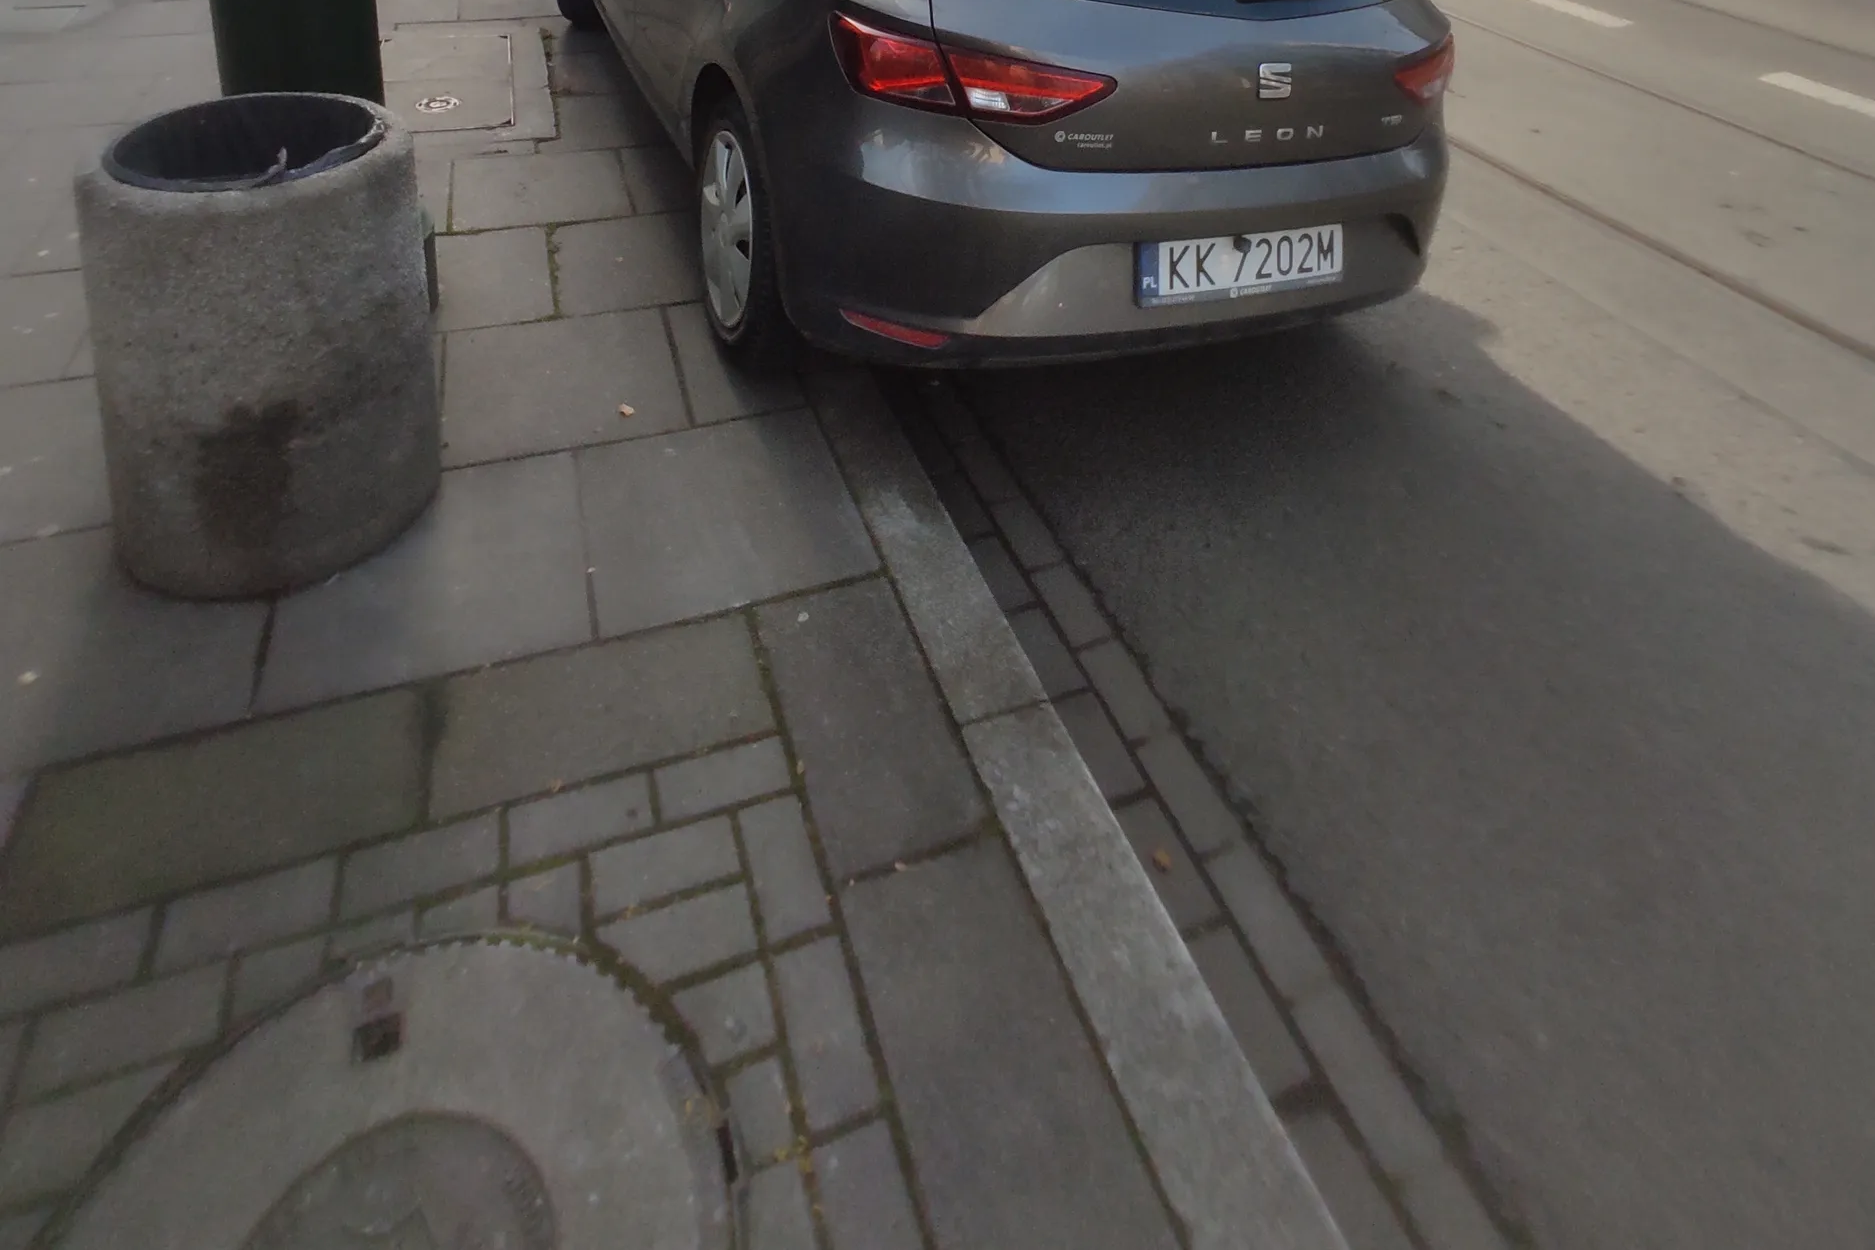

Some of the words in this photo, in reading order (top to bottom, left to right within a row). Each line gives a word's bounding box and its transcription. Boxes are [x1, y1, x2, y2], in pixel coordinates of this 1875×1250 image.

[1211, 125, 1323, 144] LEON
[1168, 241, 1216, 291] KK
[1142, 276, 1158, 290] PL
